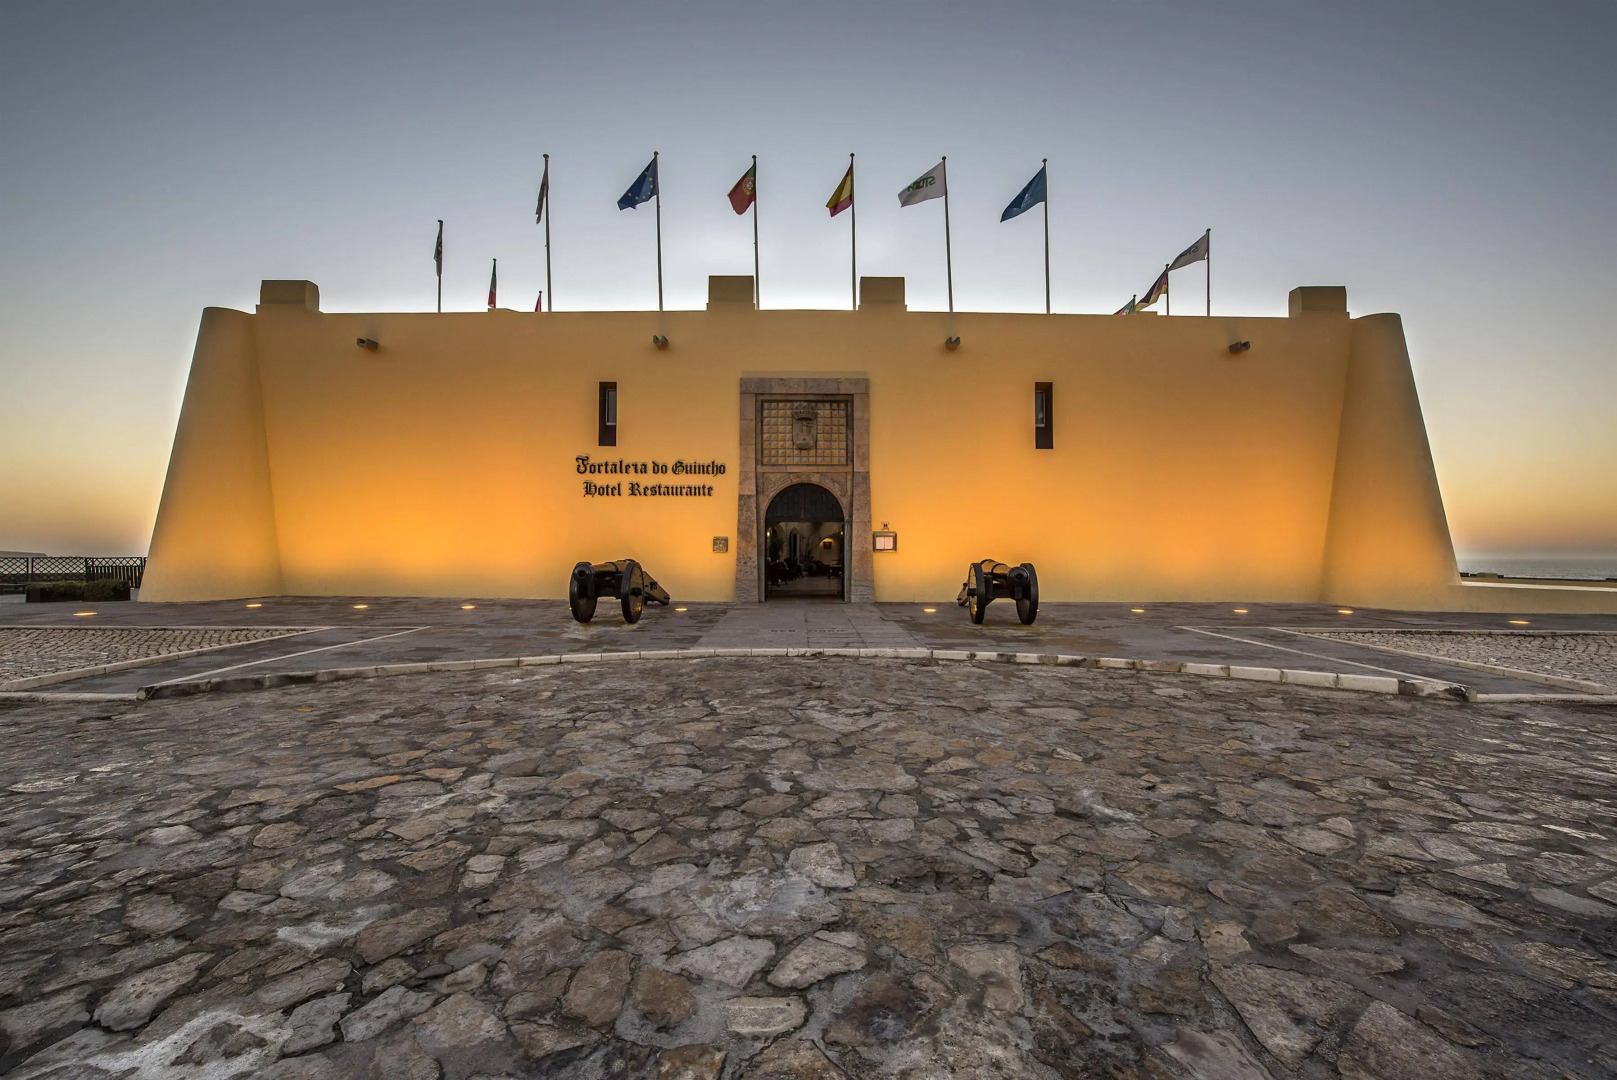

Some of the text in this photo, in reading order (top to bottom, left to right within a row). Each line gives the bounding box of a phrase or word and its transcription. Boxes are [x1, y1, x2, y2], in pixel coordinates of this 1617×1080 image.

[651, 461, 668, 475] do
[672, 460, 726, 477] Guincho
[583, 481, 713, 498] Hotel Restaurante
